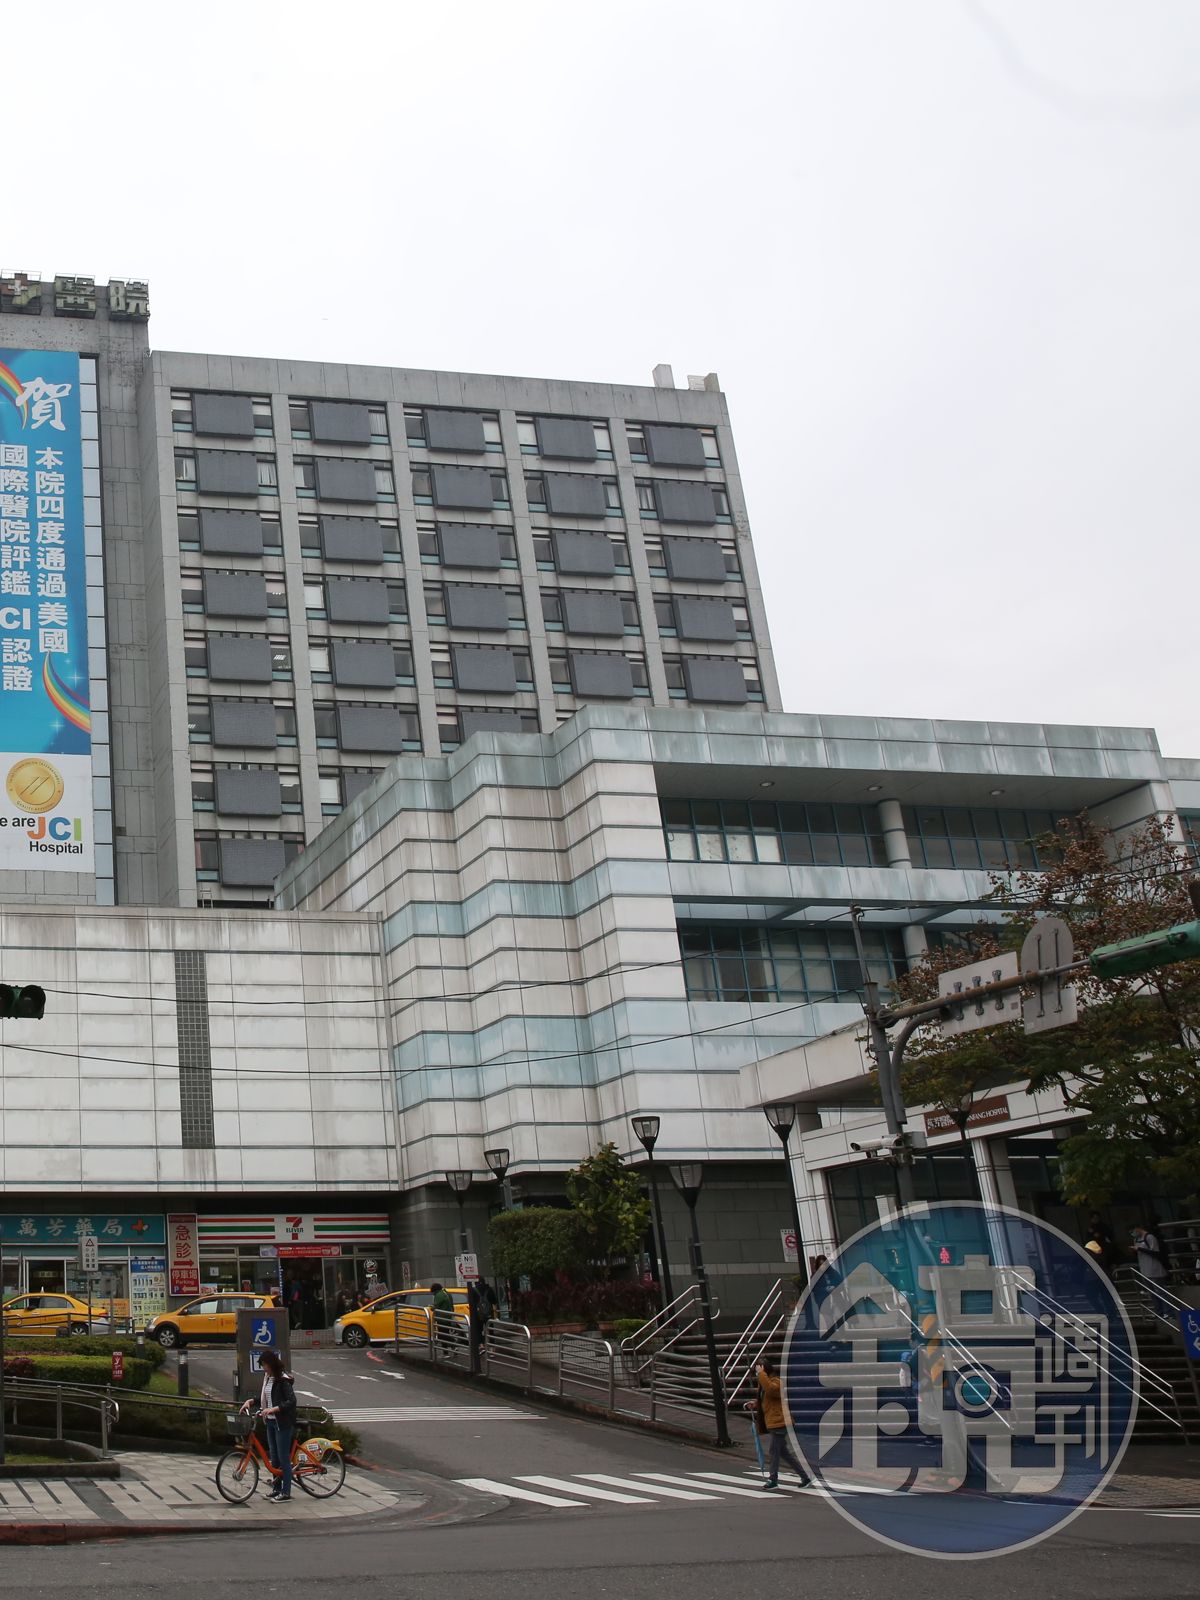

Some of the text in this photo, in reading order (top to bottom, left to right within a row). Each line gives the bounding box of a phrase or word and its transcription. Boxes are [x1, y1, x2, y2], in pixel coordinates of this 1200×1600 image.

[15, 377, 72, 431] 賀
[0, 444, 32, 596] 國際醫院評鑑
[35, 447, 68, 654] 本院四度通過美國
[1, 638, 32, 691] 認證
[12, 816, 36, 828] are
[27, 816, 82, 842] JCI
[29, 841, 83, 856] Hospital
[17, 1217, 123, 1237] 萬芳藥局
[176, 1225, 191, 1258] 急診
[172, 1269, 198, 1280] 停車場
